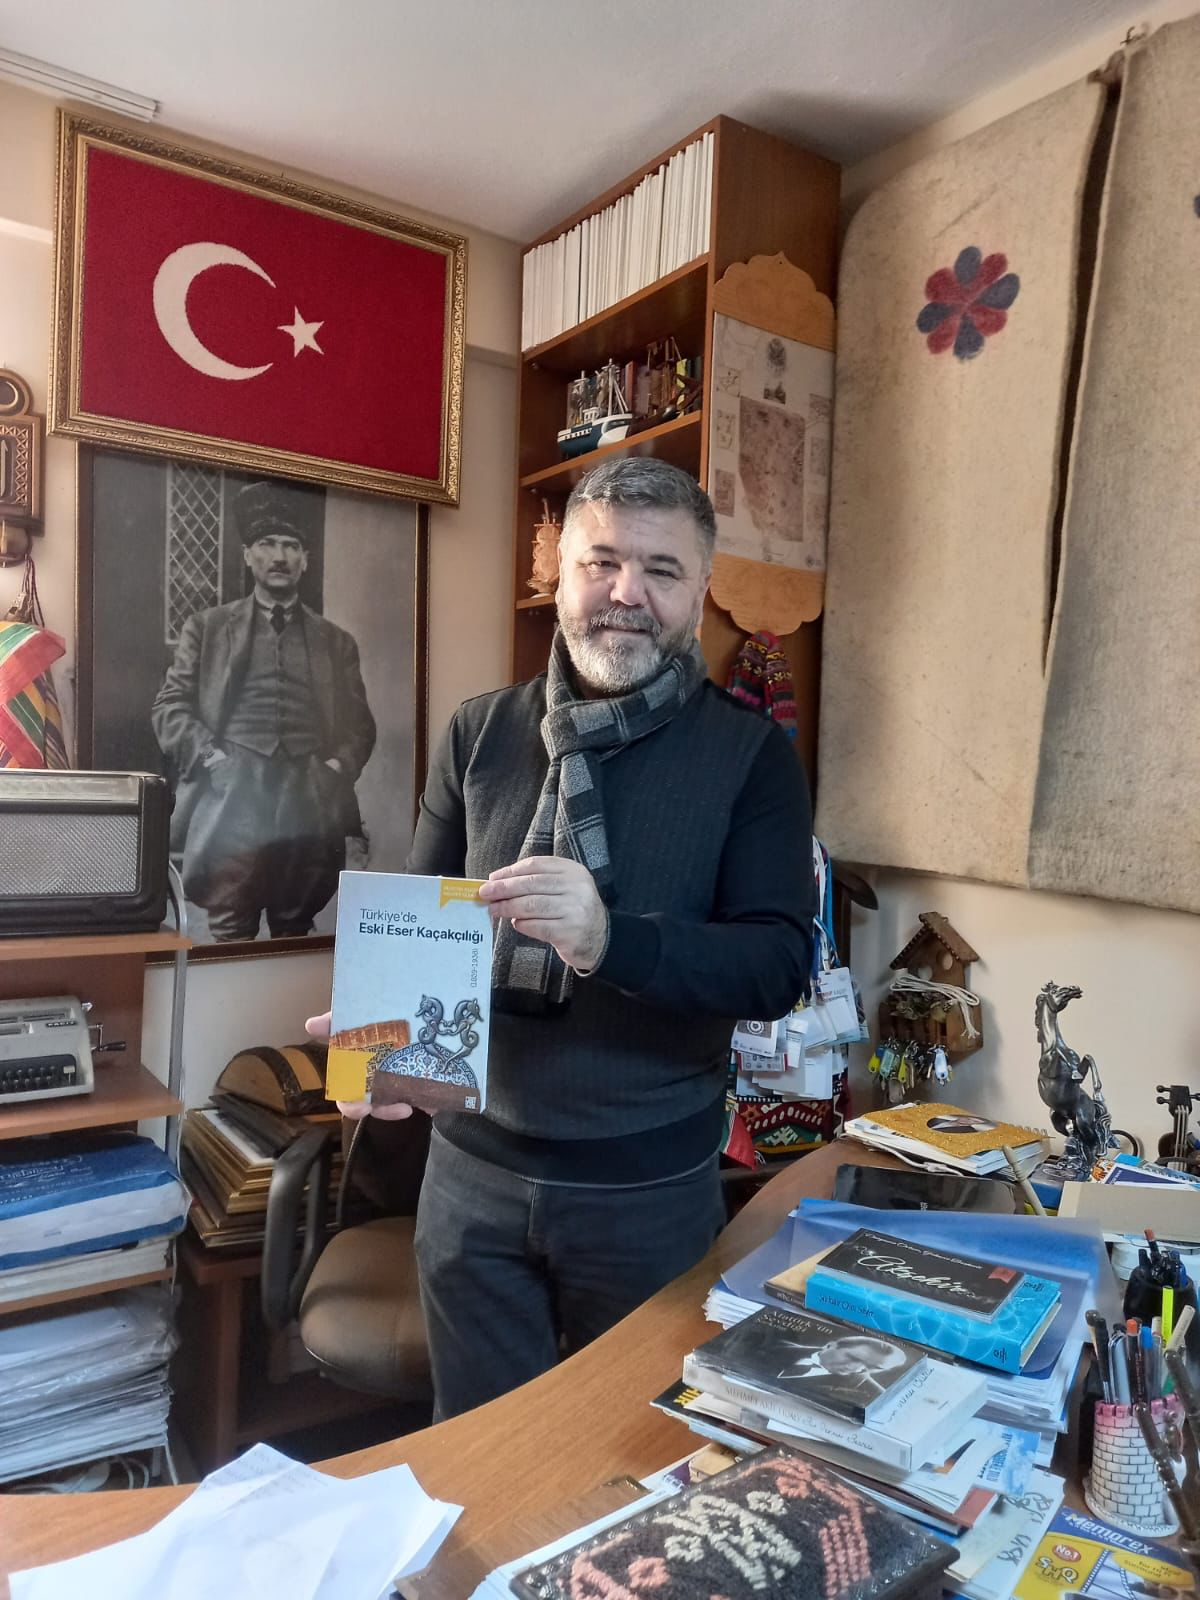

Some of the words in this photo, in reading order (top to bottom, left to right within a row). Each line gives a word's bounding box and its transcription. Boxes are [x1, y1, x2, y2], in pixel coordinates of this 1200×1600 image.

[360, 908, 417, 925] Türkiye'de
[359, 922, 384, 935] Eski
[386, 924, 413, 937] Eser
[416, 926, 484, 943] Kaçakçılığı
[1065, 1513, 1154, 1555] Memorex
[1055, 1544, 1079, 1561] No.1
[1036, 1556, 1079, 1584] SHQ
